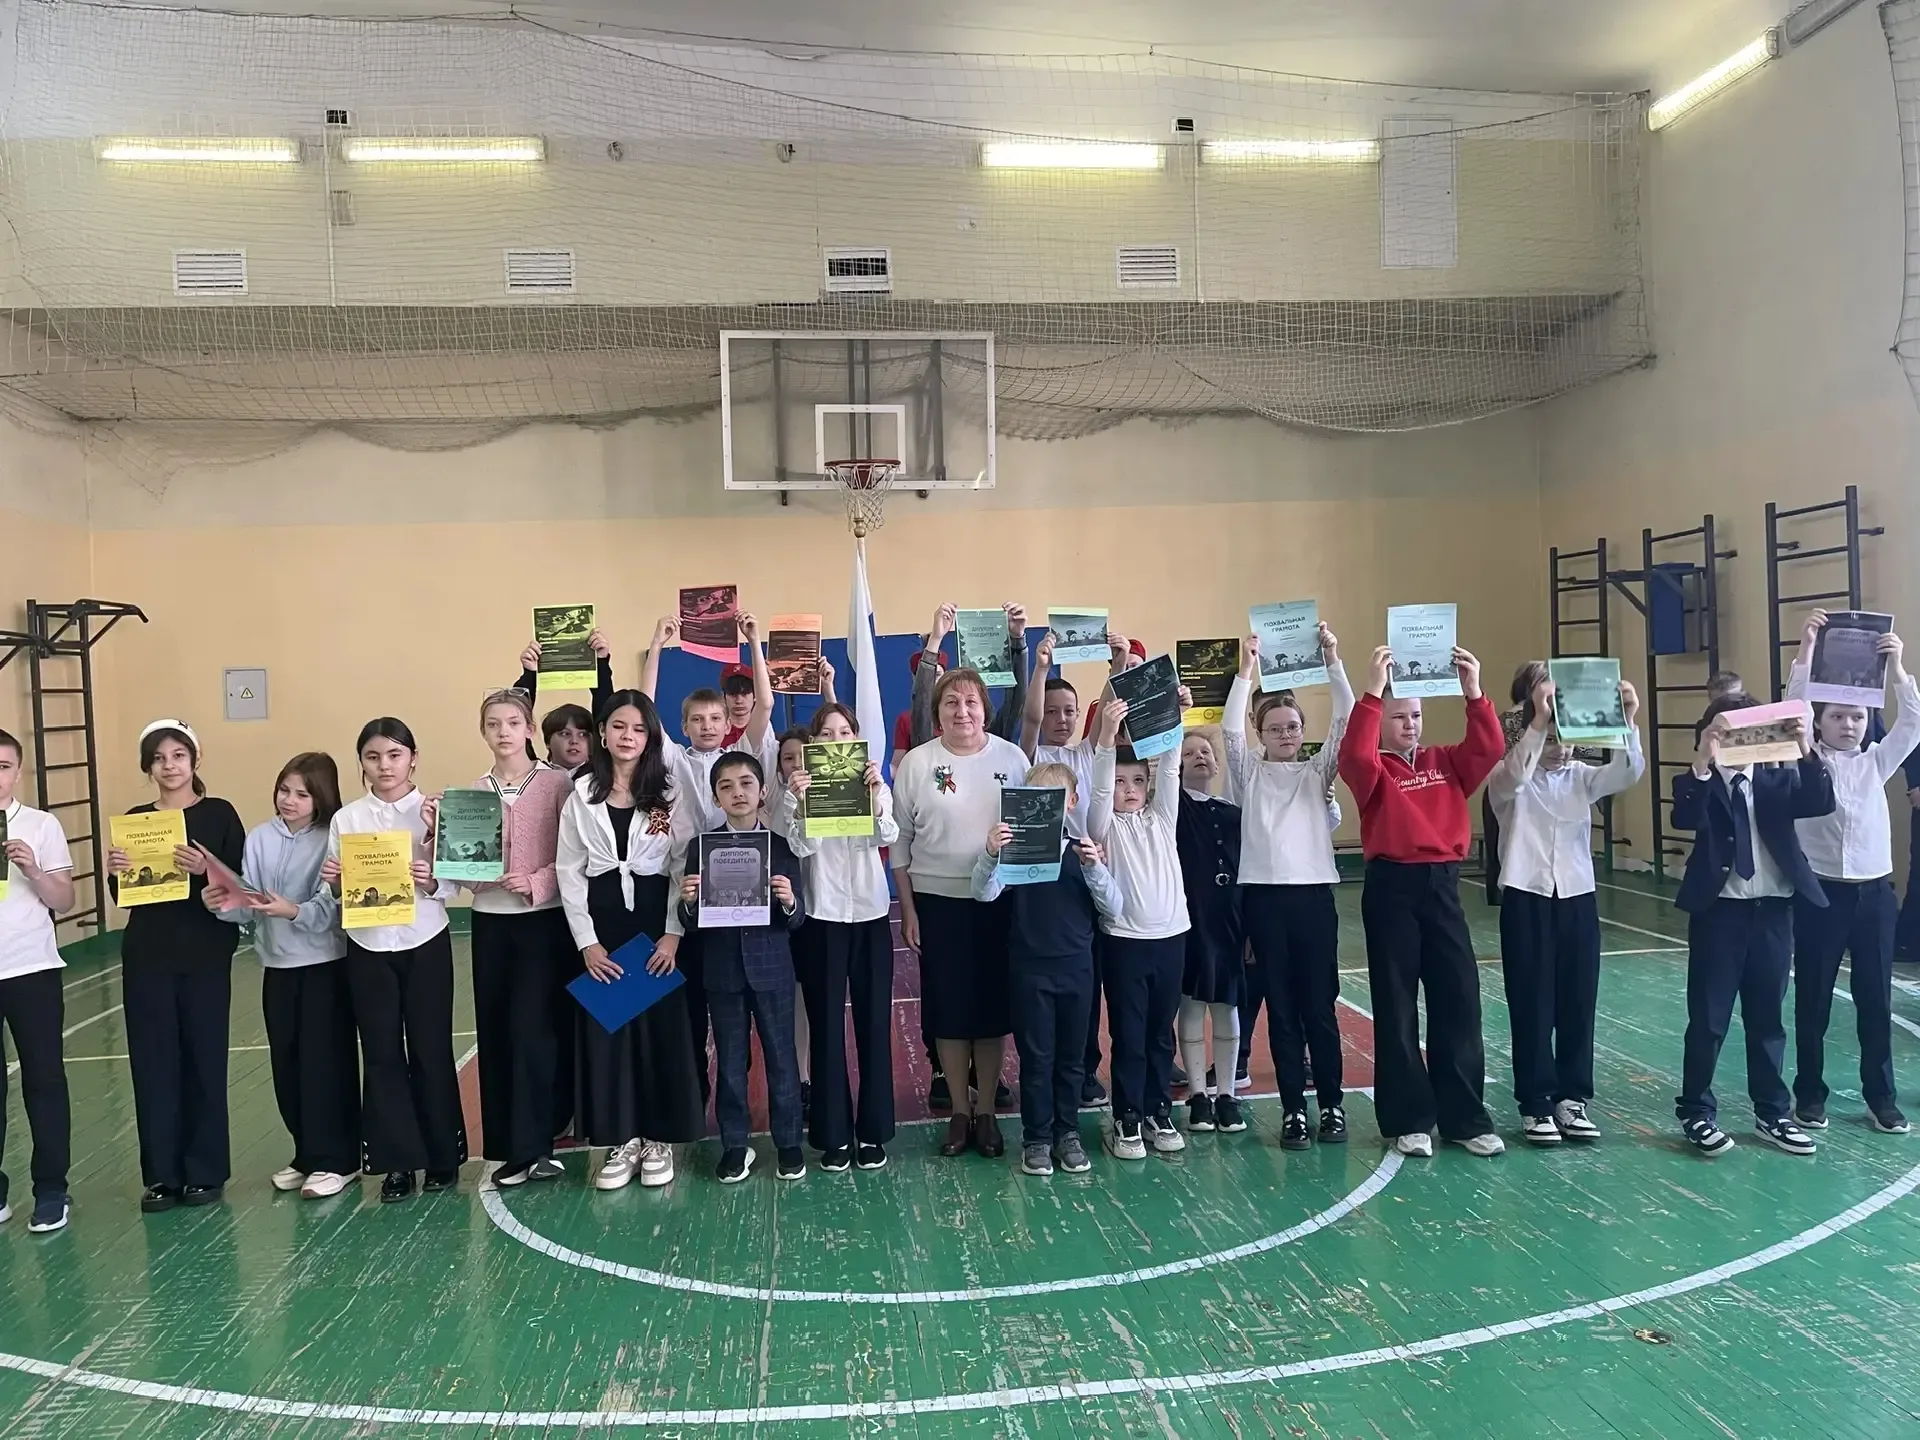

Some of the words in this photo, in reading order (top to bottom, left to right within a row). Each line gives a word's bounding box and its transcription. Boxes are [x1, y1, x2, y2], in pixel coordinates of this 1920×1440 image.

[1263, 616, 1306, 628] ПОХВАЛЬНАЯ
[1271, 624, 1300, 633] ГРАМОТА
[126, 829, 173, 840] ПОХВАЛЬНАЯ
[134, 837, 166, 845] ГРАМОТА
[354, 852, 400, 860] ПОХВАЛЬНАЯ
